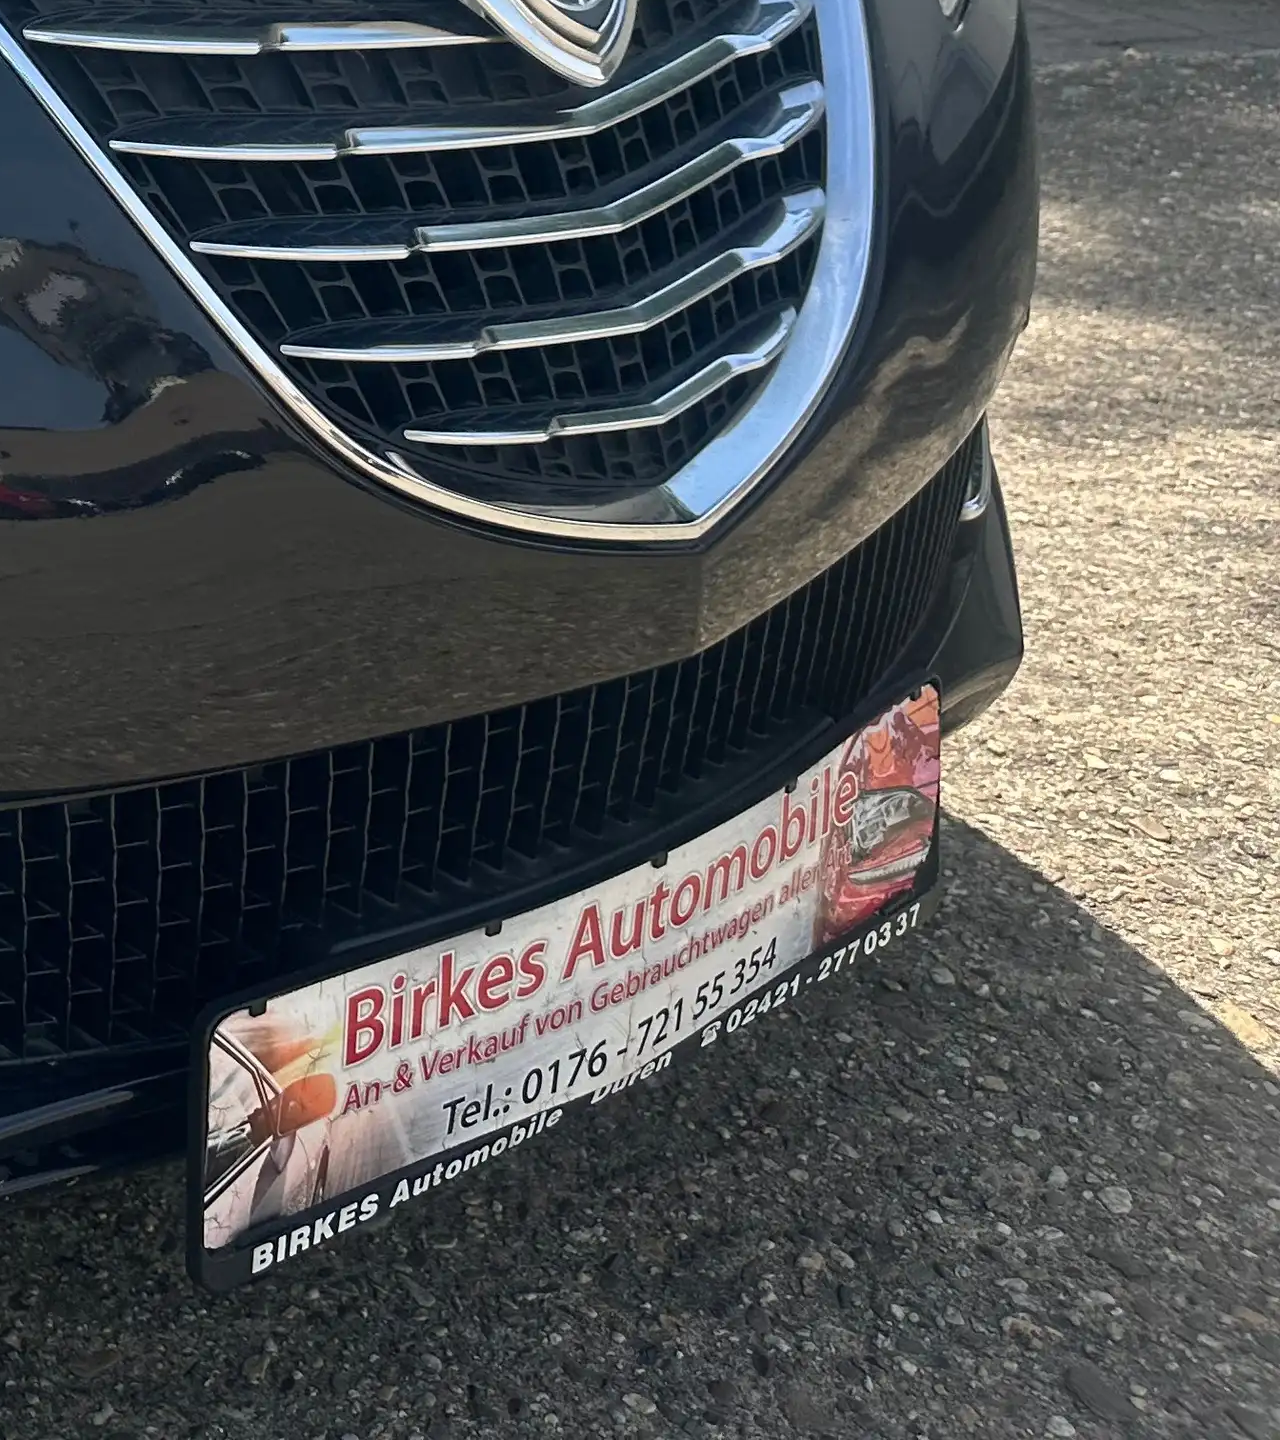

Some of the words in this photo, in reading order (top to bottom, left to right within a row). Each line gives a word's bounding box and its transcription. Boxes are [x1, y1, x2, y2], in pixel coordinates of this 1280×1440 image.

[343, 940, 548, 1067] Birkes
[561, 766, 859, 982] Automobile
[420, 1013, 530, 1082] Verkauf
[535, 998, 583, 1037] von
[590, 892, 774, 1014] Gebrauchtwagen
[443, 1083, 510, 1136] Tel.:
[521, 1039, 607, 1105] 0176
[636, 997, 684, 1057] 721
[692, 971, 726, 1021] 55
[729, 936, 777, 995] 354
[251, 1193, 379, 1274] BIRKES
[389, 1107, 564, 1208] Automobile
[726, 973, 801, 1034] 02421
